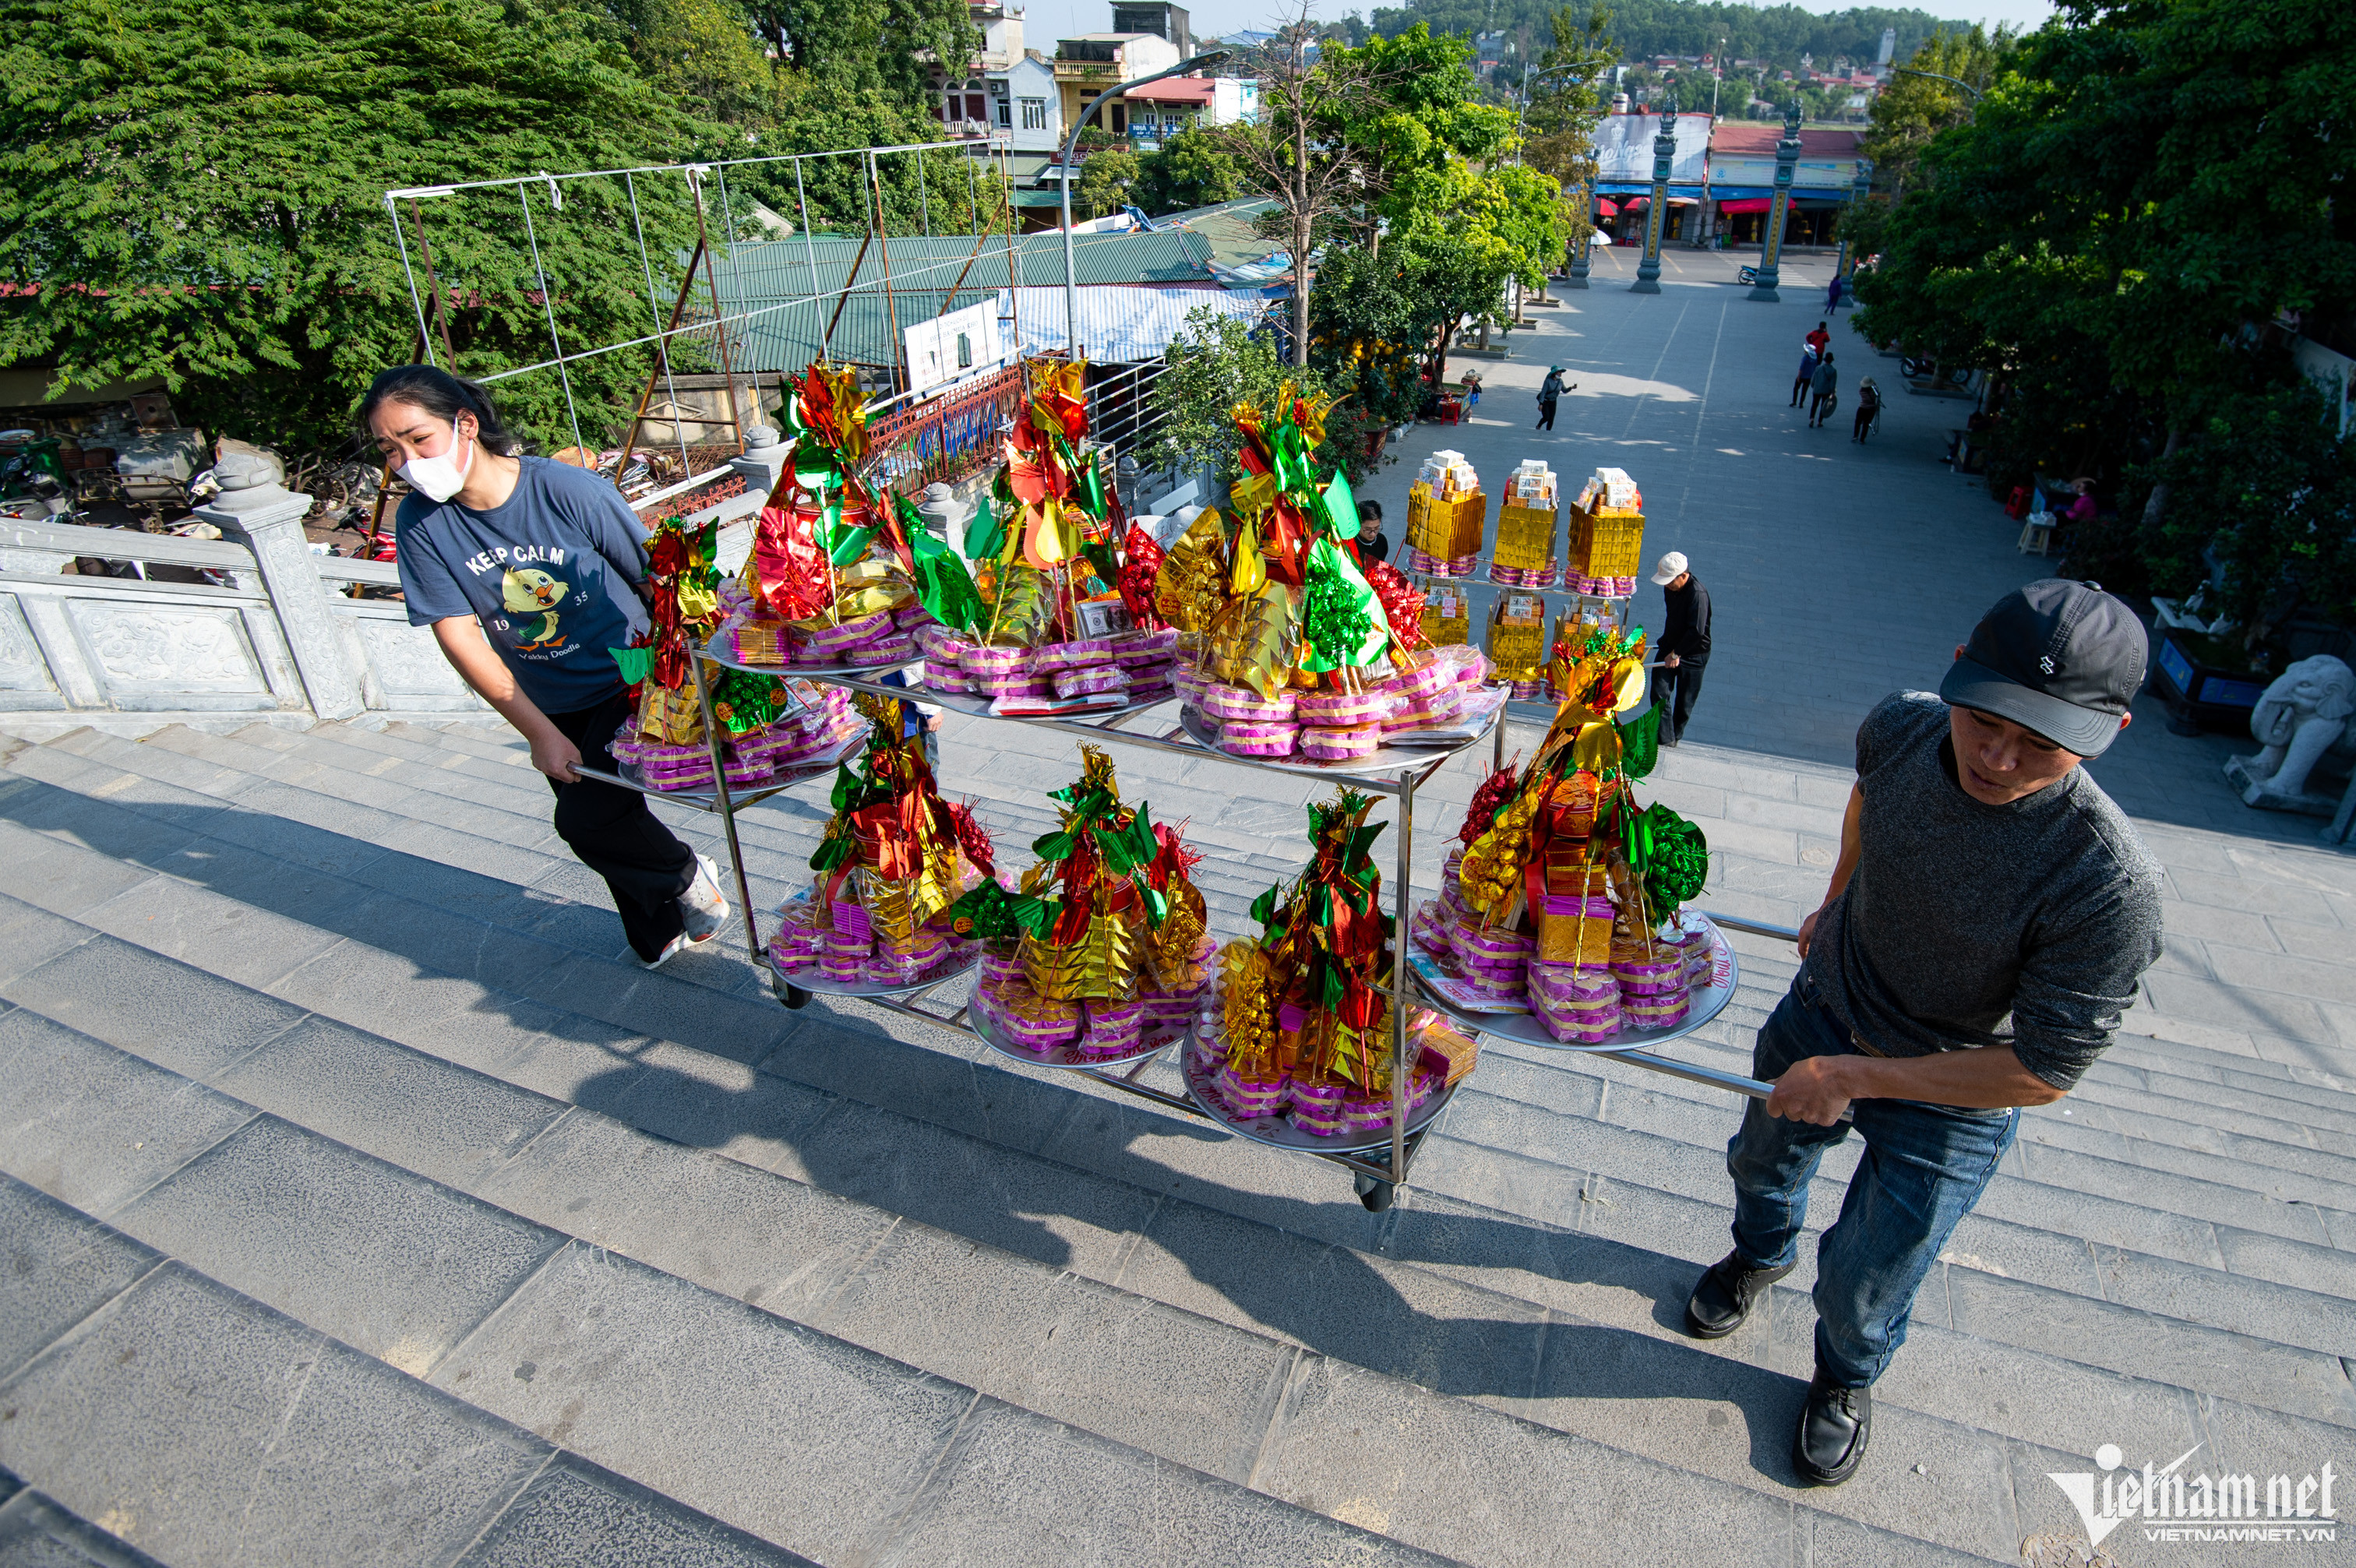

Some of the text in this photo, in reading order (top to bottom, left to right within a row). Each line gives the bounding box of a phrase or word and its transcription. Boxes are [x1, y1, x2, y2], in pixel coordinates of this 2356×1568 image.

[465, 544, 566, 576] KEEP CALM
[493, 591, 588, 631] 19 35
[519, 643, 580, 661] Yakky Doodle
